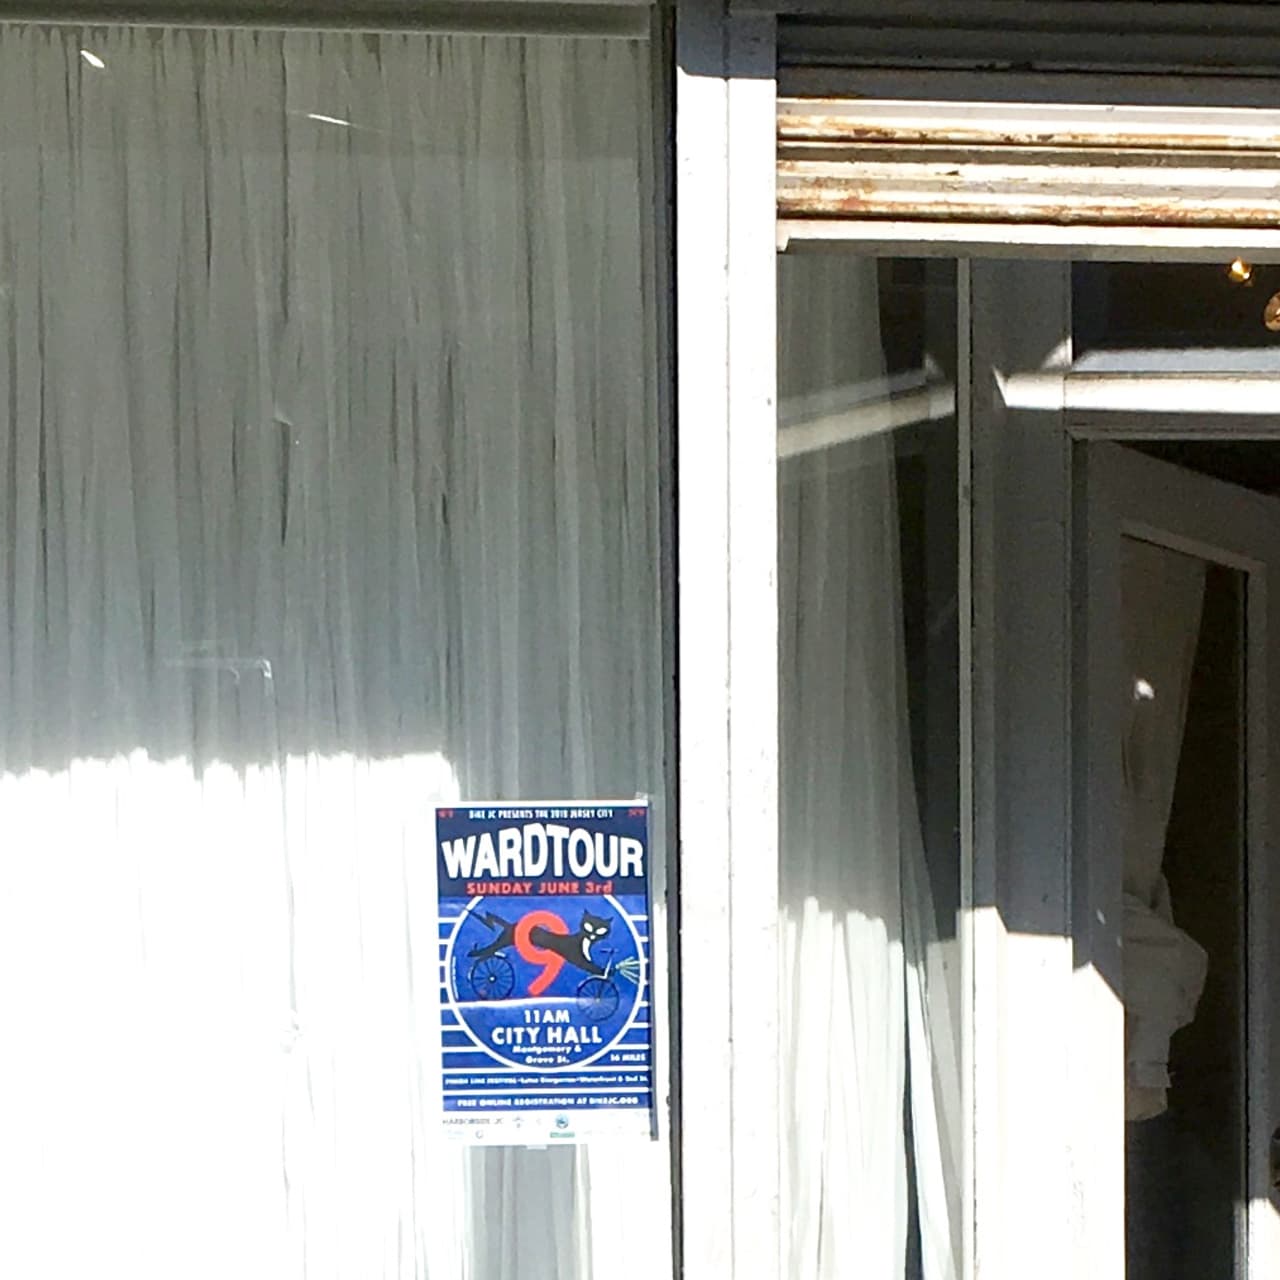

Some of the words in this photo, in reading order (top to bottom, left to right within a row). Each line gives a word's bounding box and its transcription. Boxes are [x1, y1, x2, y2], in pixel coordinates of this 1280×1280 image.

[498, 809, 532, 819] PRESENTS
[597, 808, 614, 818] CITY
[441, 823, 644, 878] WARDTOUR
[466, 882, 532, 896] SUNDAY
[538, 881, 580, 896] JUNE
[585, 880, 614, 895] 3rd
[524, 1009, 570, 1025] 11AM
[492, 1027, 544, 1046] CITY
[548, 1026, 602, 1044] HALL
[512, 1044, 572, 1055] Montgomery
[525, 1055, 554, 1065] Grove
[622, 1053, 646, 1062] MILES
[479, 1098, 512, 1107] ONLINE
[514, 1097, 575, 1107] REGISTRATION
